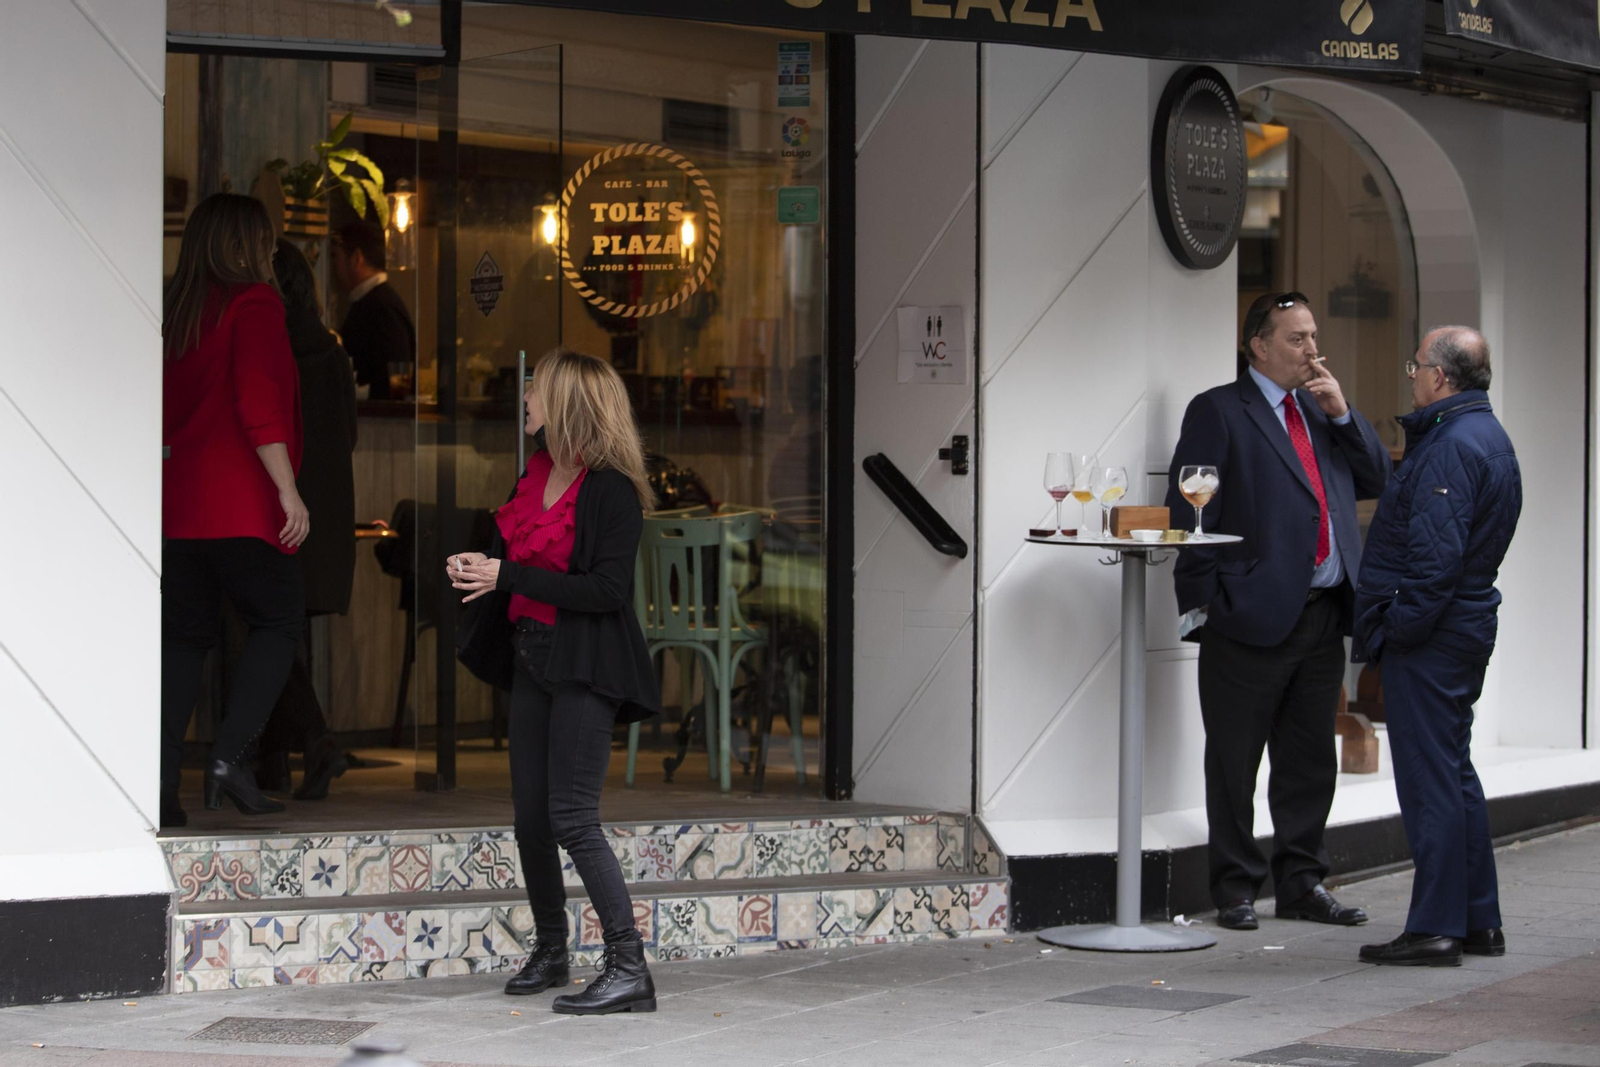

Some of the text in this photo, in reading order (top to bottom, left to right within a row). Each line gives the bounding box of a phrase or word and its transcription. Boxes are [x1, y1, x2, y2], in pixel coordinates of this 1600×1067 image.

[857, 0, 1104, 32] AZA
[1321, 39, 1399, 60] CANDELAS
[1185, 122, 1229, 150] TOLE'S
[781, 149, 811, 159] LaLiga
[1187, 153, 1226, 180] PLAZA
[604, 181, 632, 189] CAFE
[646, 180, 669, 188] BAR
[590, 202, 684, 223] TOLE'S
[592, 234, 683, 256] PLAZA
[637, 263, 674, 271] DRINKS
[922, 341, 947, 360] WC
